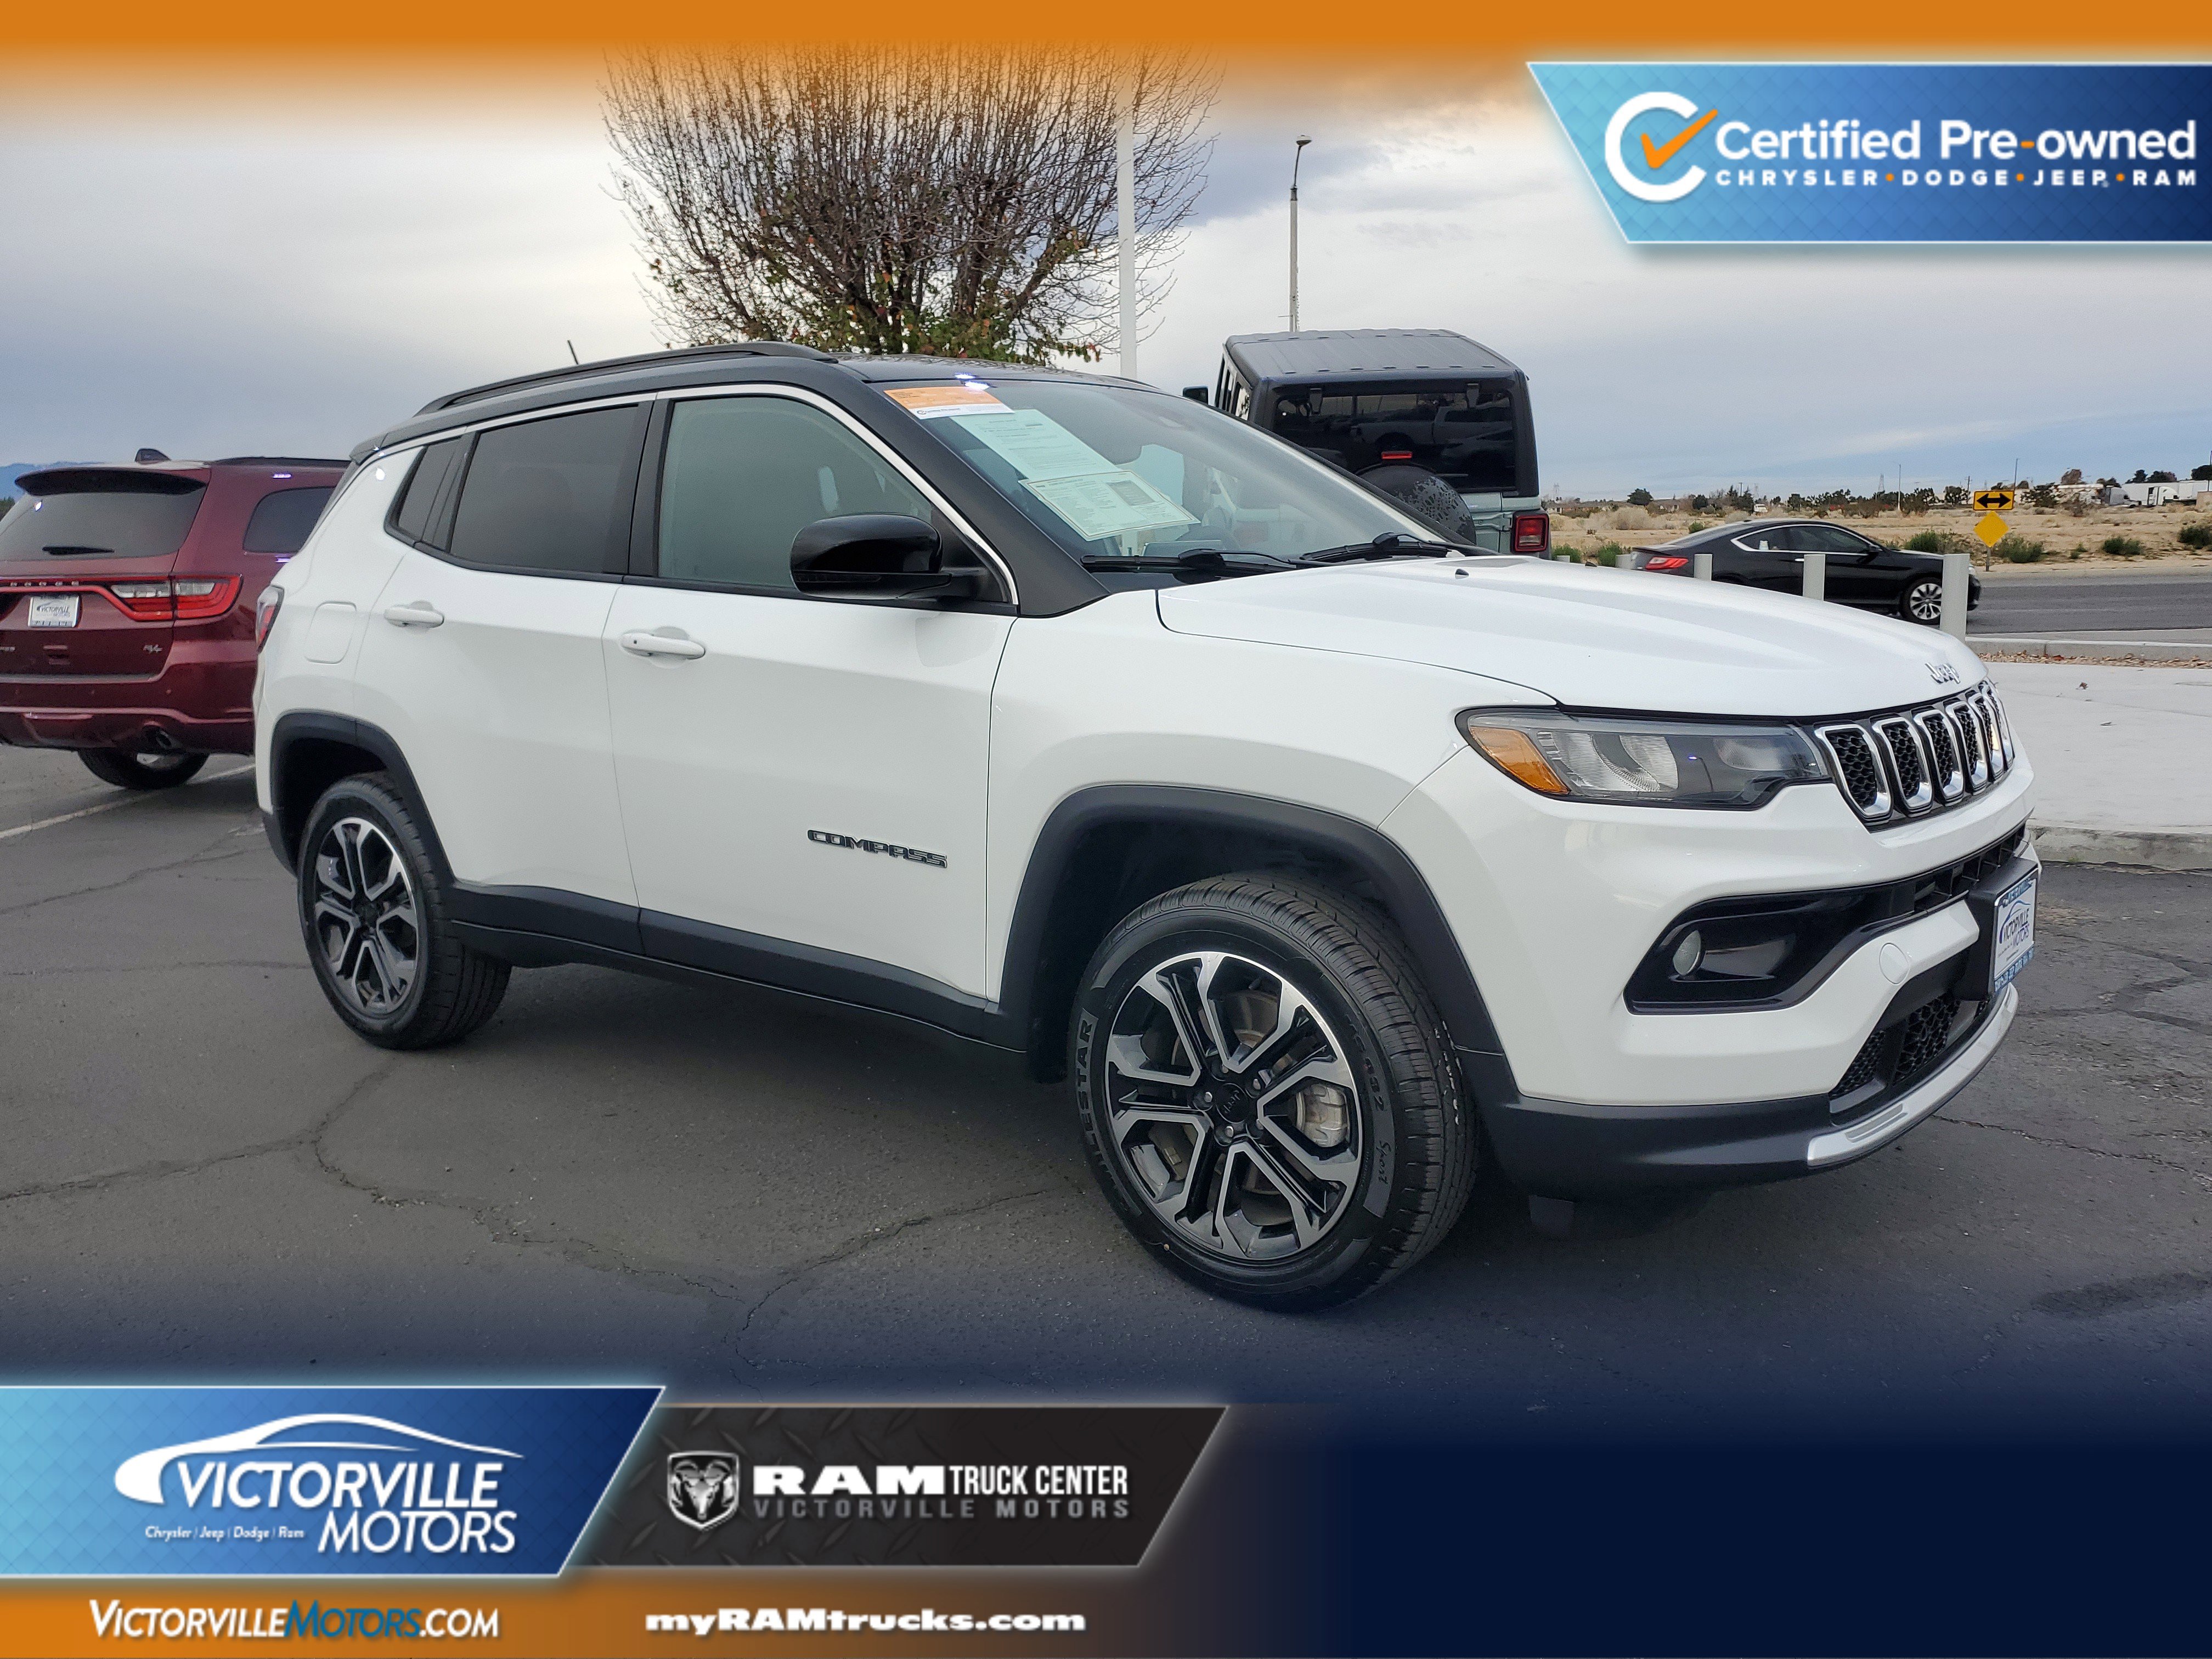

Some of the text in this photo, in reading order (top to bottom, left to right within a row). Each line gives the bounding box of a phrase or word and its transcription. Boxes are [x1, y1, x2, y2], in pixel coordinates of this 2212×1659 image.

[1925, 662, 1961, 684] Jeep
[808, 829, 948, 868] COMPASS
[2003, 907, 2030, 943] VICTORVILLE
